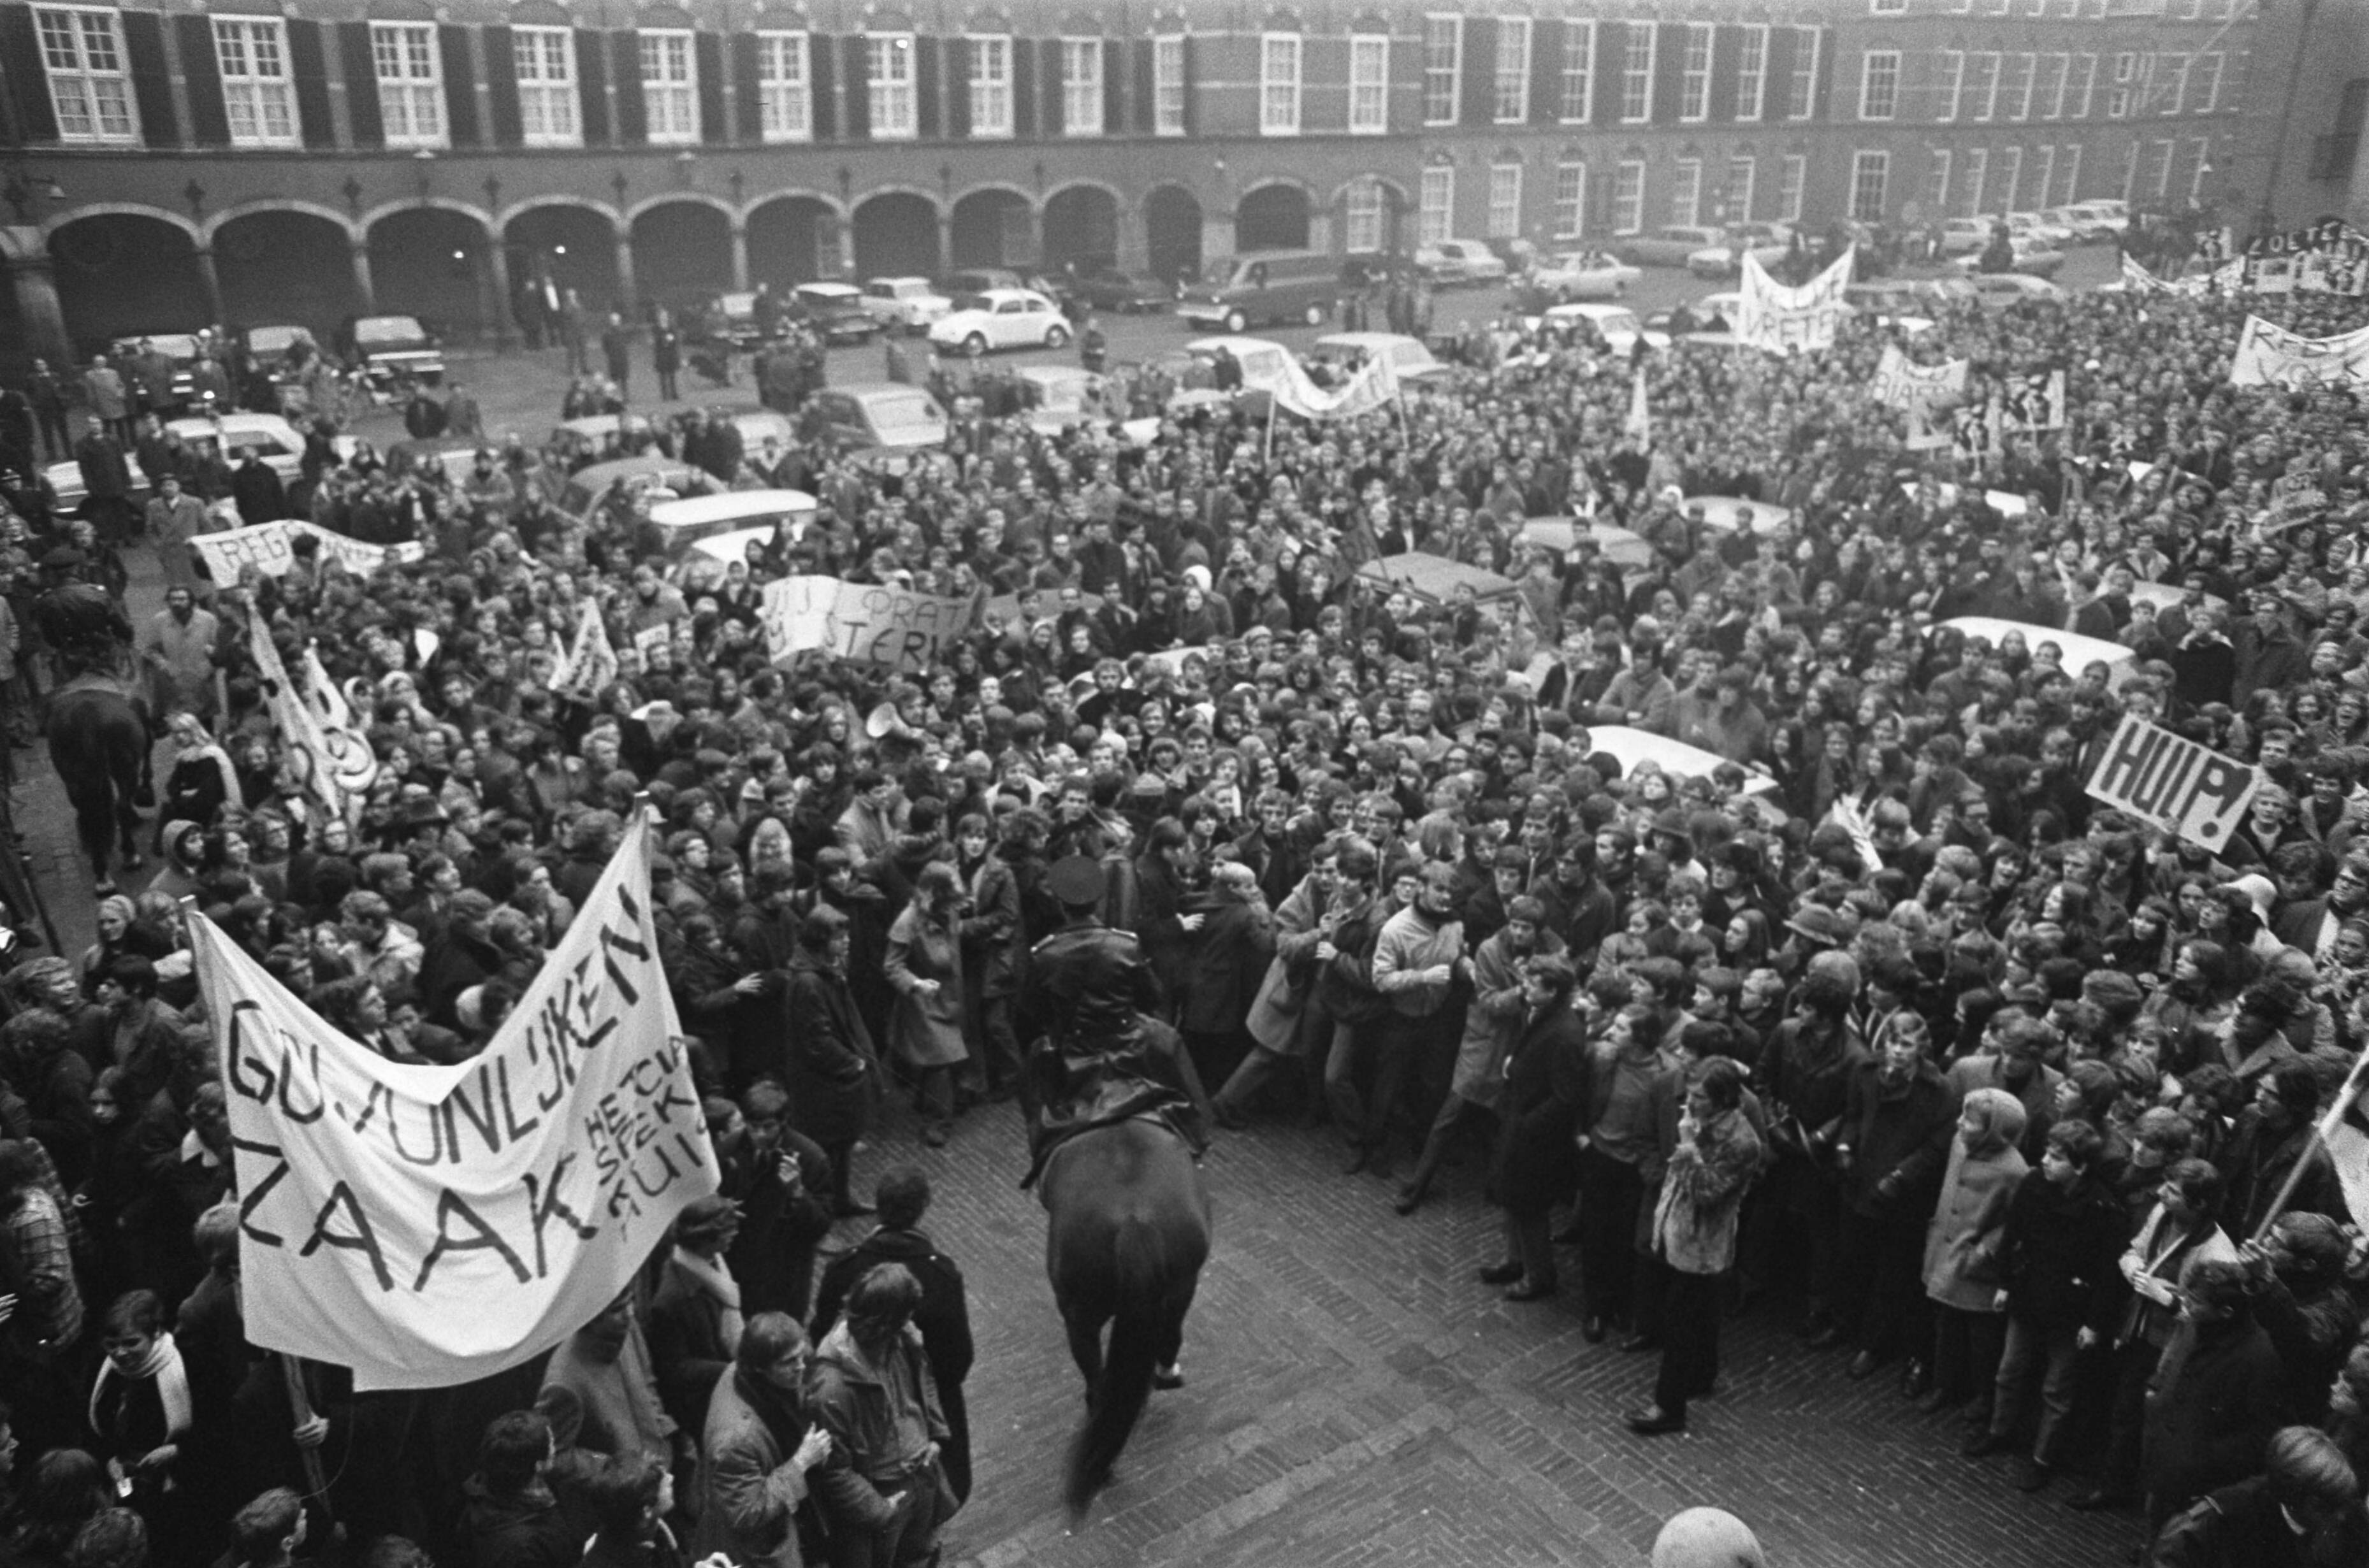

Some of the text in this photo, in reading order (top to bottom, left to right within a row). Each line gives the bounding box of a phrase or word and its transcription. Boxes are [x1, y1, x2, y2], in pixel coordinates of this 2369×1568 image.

[2099, 721, 2253, 838] HULP!
[595, 1084, 696, 1186] SPEK
[232, 1134, 598, 1292] ZAAK
